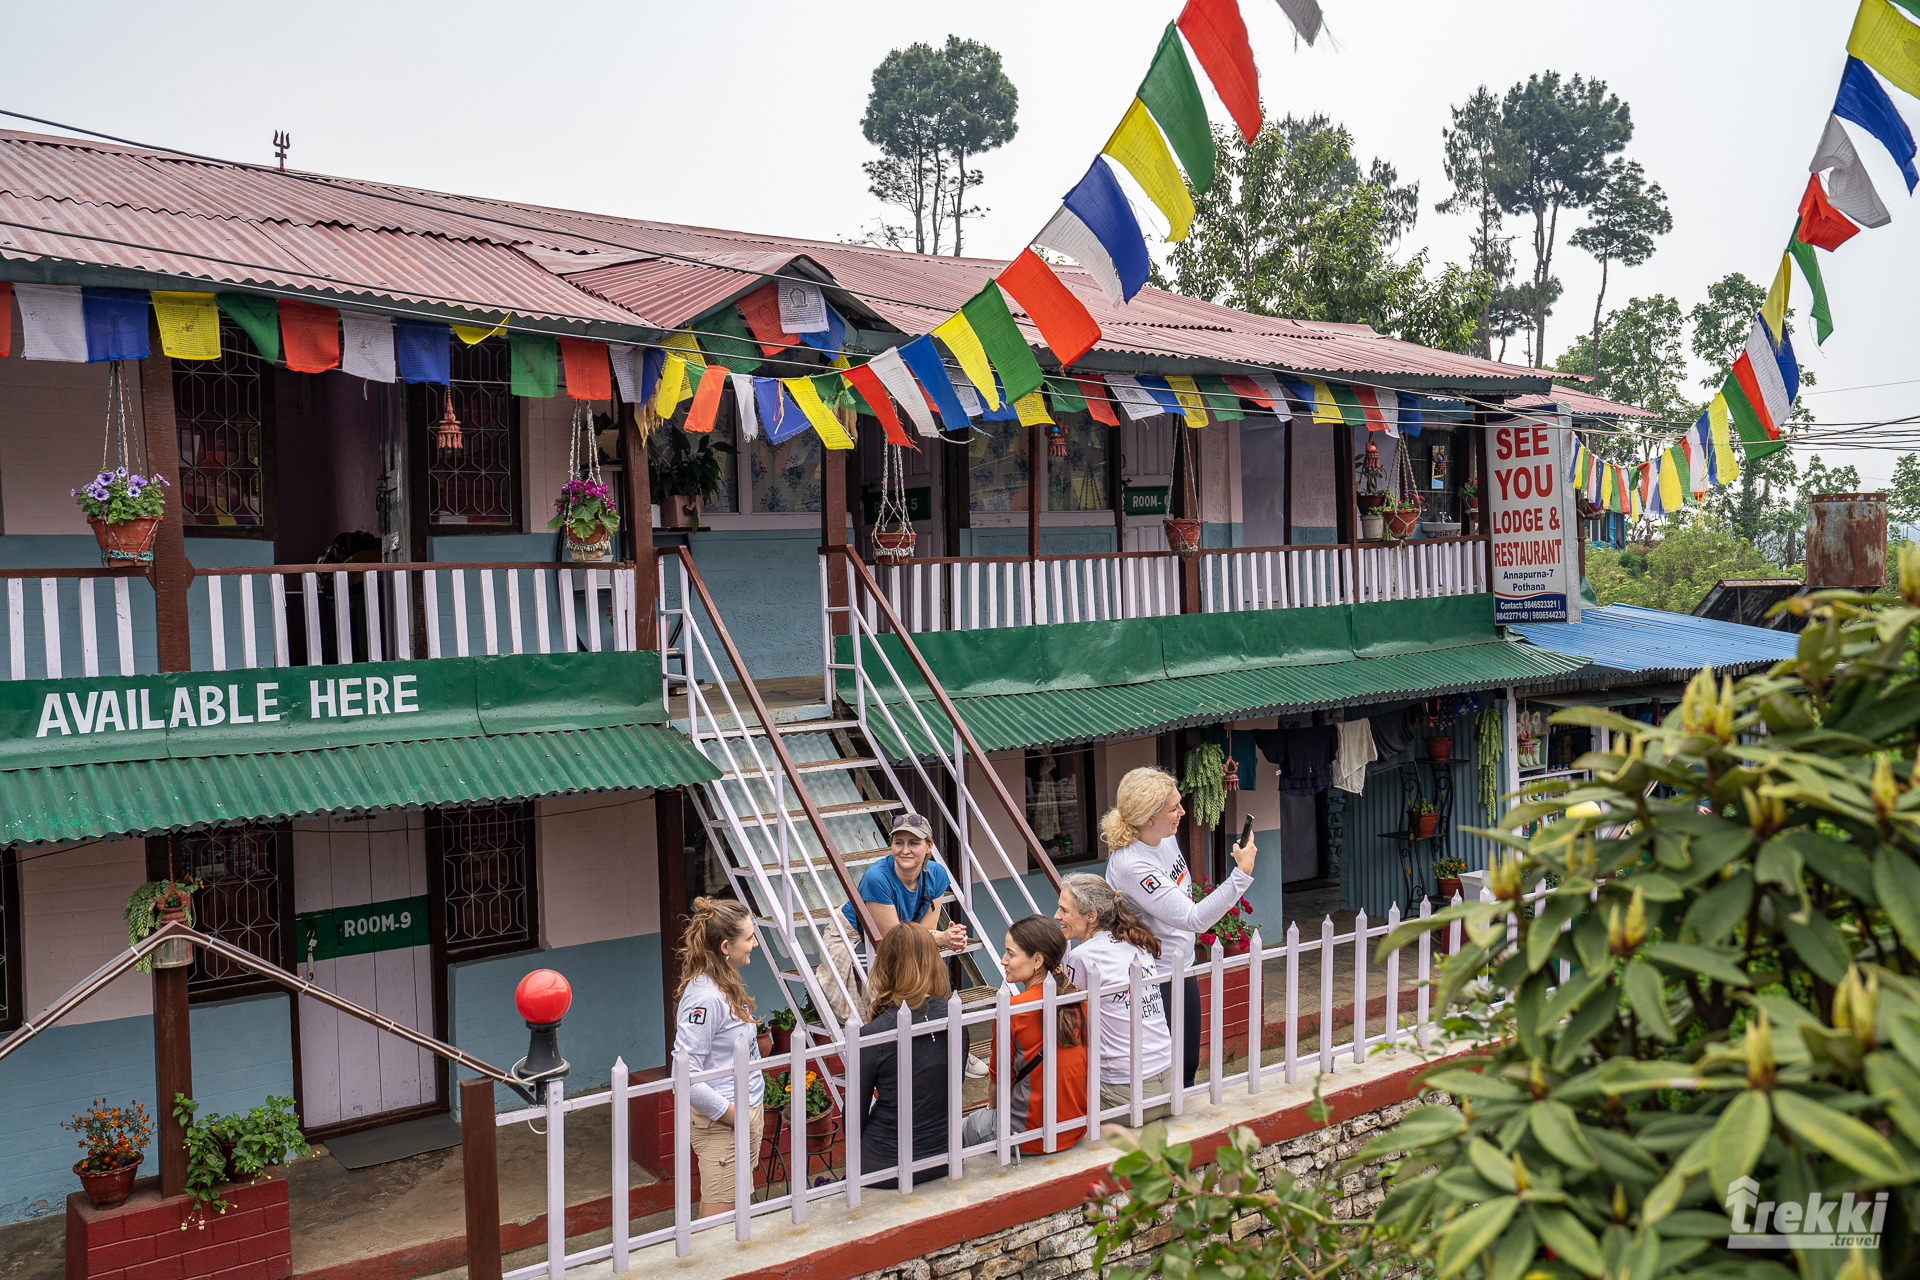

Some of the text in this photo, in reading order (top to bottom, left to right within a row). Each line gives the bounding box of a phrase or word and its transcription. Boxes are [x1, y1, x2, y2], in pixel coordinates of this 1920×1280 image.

[1496, 423, 1549, 460] SEE
[1494, 464, 1553, 500] YOU
[1492, 506, 1560, 534] LODGE &
[1494, 539, 1562, 567] RESTAURANT
[1503, 569, 1554, 580] Annapurna-7
[1512, 583, 1546, 591] Pothana
[1500, 601, 1523, 610] Contact:
[1523, 600, 1557, 609] 9846523321
[36, 674, 420, 738] AVAILABLE HERE
[1165, 854, 1186, 883] rekki
[344, 911, 412, 937] ROOM-9
